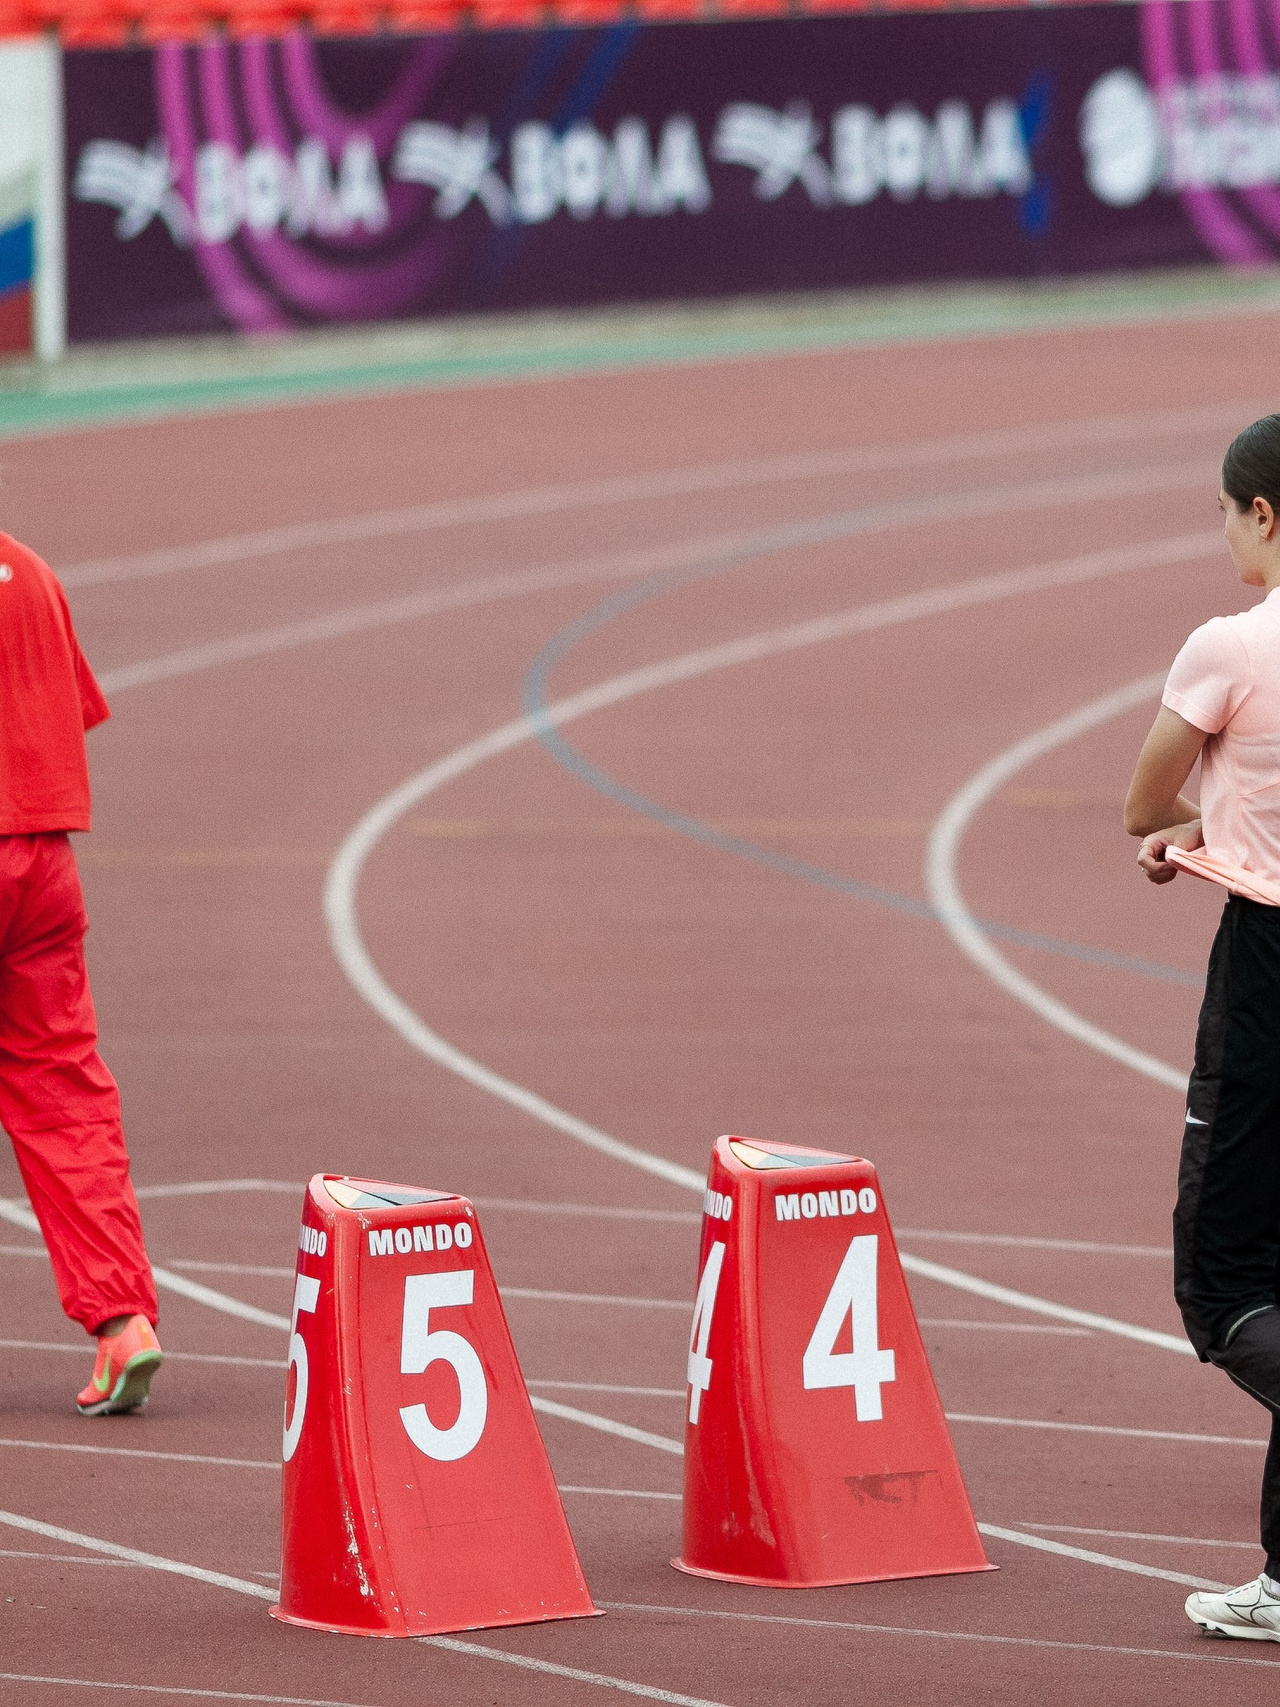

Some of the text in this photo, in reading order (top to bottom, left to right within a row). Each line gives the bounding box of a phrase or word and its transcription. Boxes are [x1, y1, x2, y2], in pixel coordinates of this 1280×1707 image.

[368, 1222, 473, 1256] MONDO
[775, 1188, 876, 1221] MONDO
[399, 1269, 488, 1462] 5
[687, 1241, 726, 1425] 4
[803, 1234, 896, 1421] 4
